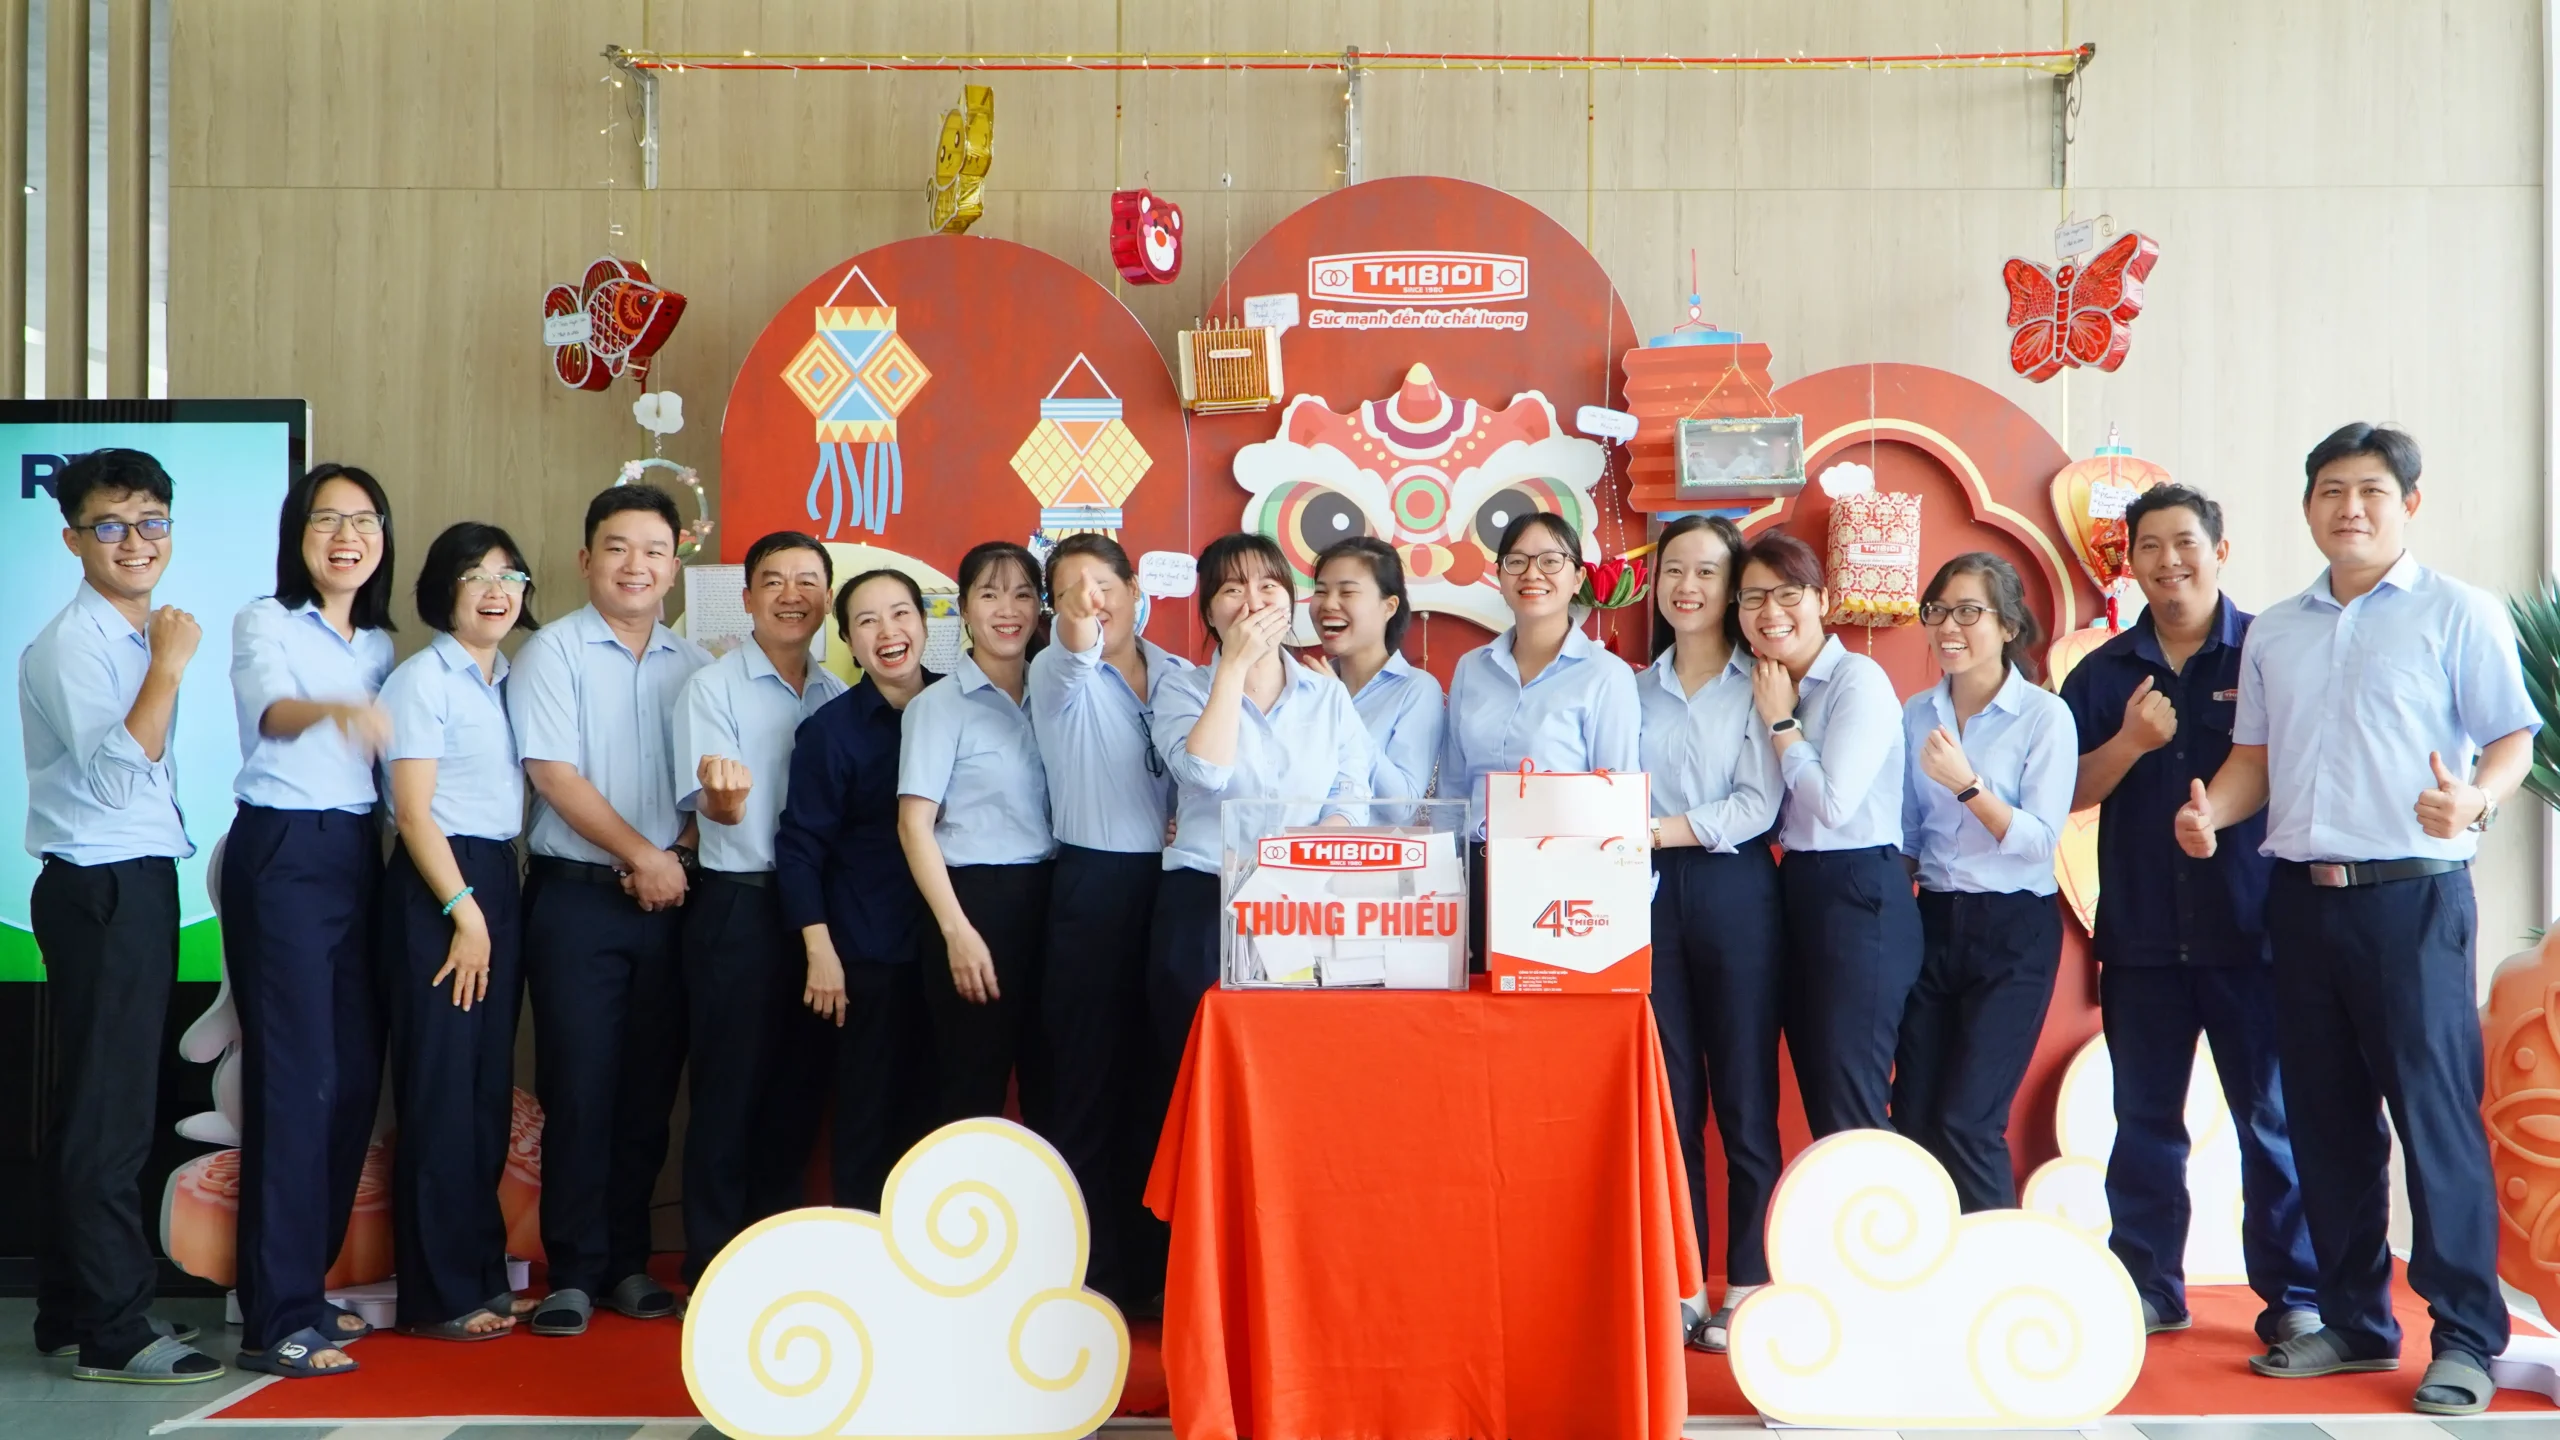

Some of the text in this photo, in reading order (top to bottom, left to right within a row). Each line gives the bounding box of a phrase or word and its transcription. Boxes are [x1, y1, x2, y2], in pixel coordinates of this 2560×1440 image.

[1363, 264, 1482, 286] THIBIDI
[1311, 309, 1525, 328] Sức mạnh đến từ chất lượng
[1863, 544, 1900, 553] THIBIDI
[1299, 842, 1394, 861] THIBIDI
[1233, 890, 1458, 937] THÙNG PHIẾU
[1532, 899, 1594, 938] 45
[1567, 918, 1609, 927] THIBIDI
